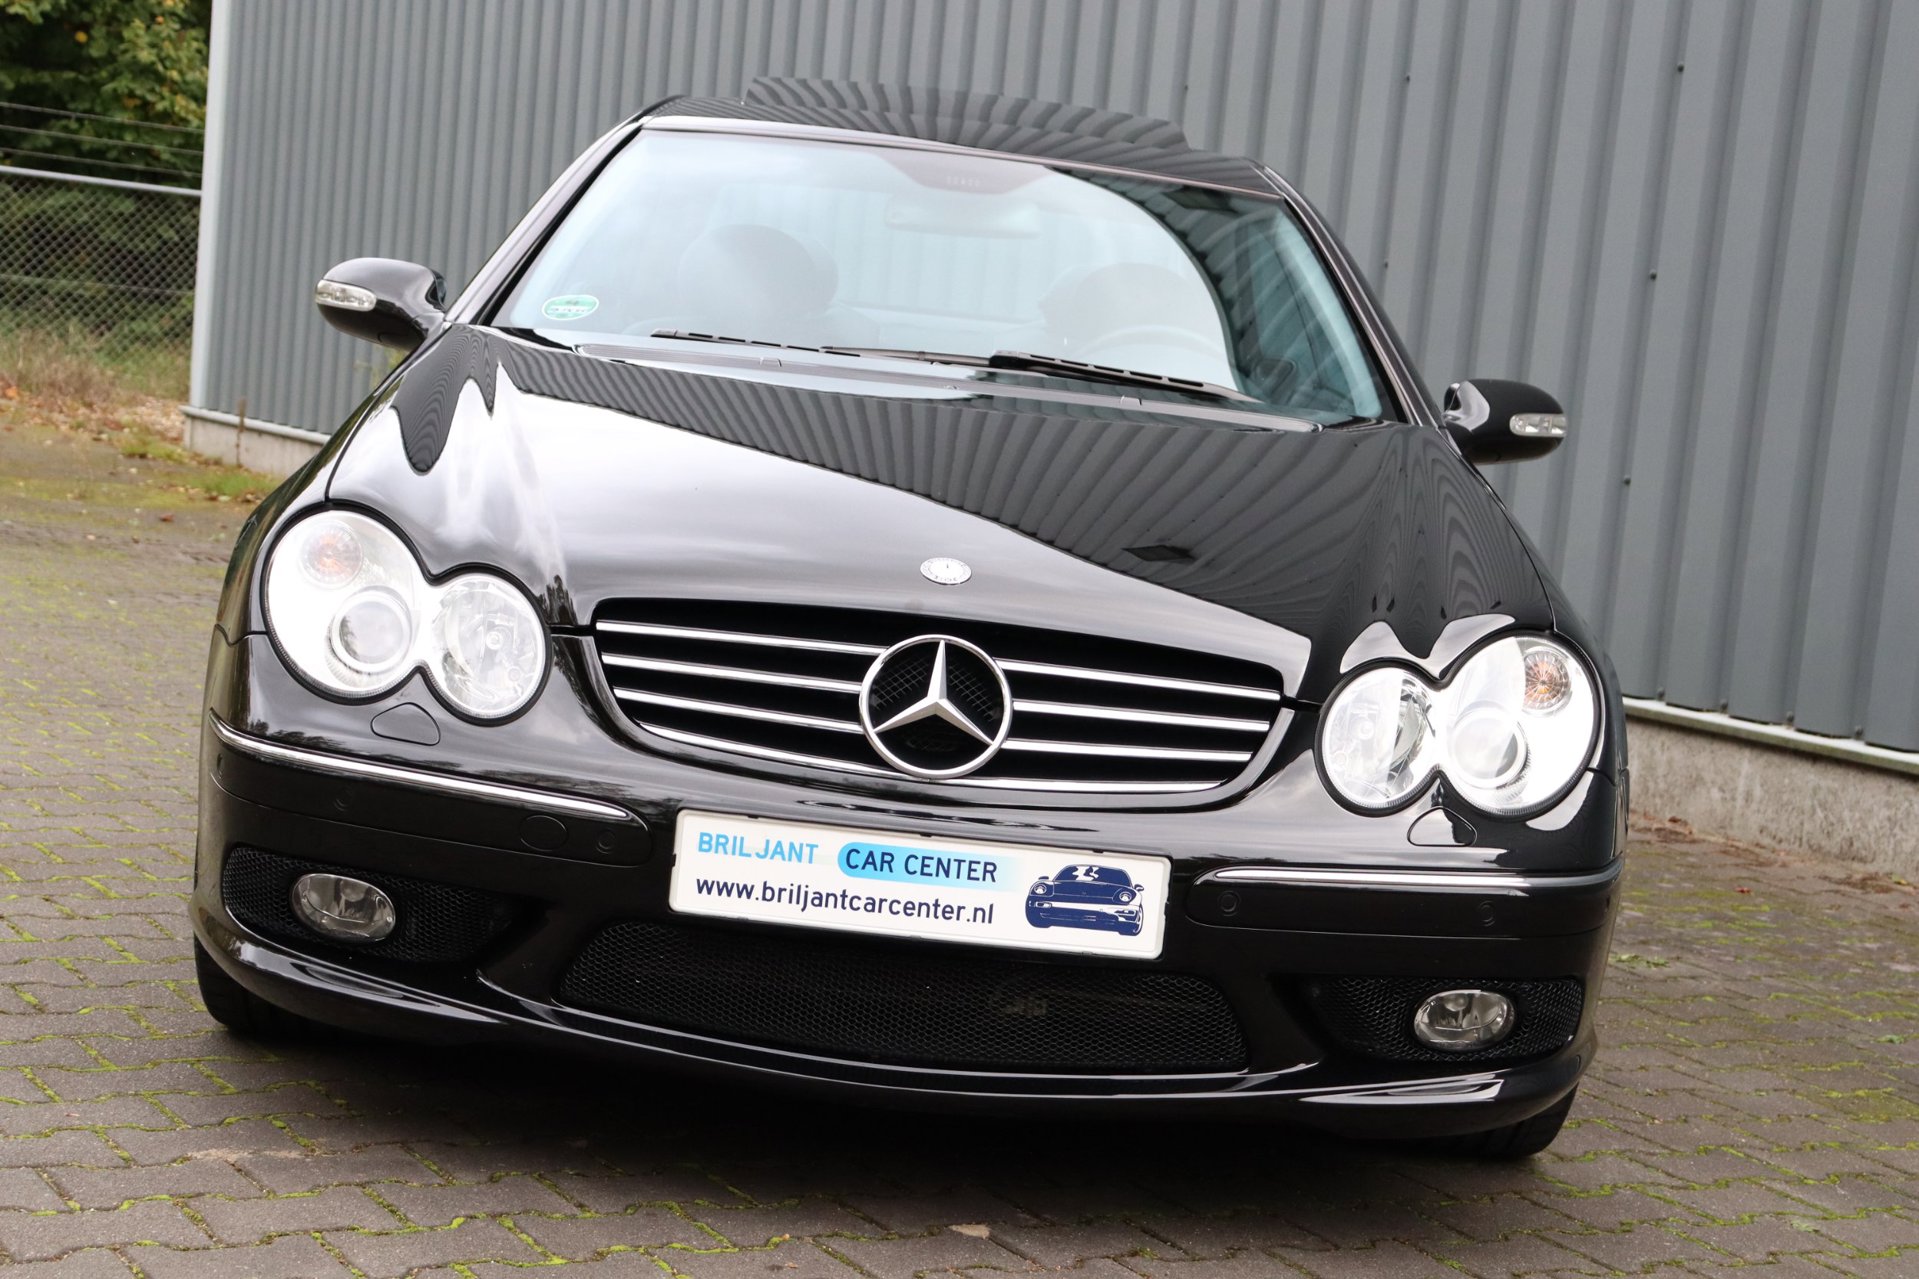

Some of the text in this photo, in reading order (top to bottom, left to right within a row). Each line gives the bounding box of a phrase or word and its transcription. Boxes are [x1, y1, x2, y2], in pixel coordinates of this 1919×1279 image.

[698, 832, 998, 883] BRILJANT CAR CENTER
[696, 878, 994, 924] www.briljantcarcenter.nl
